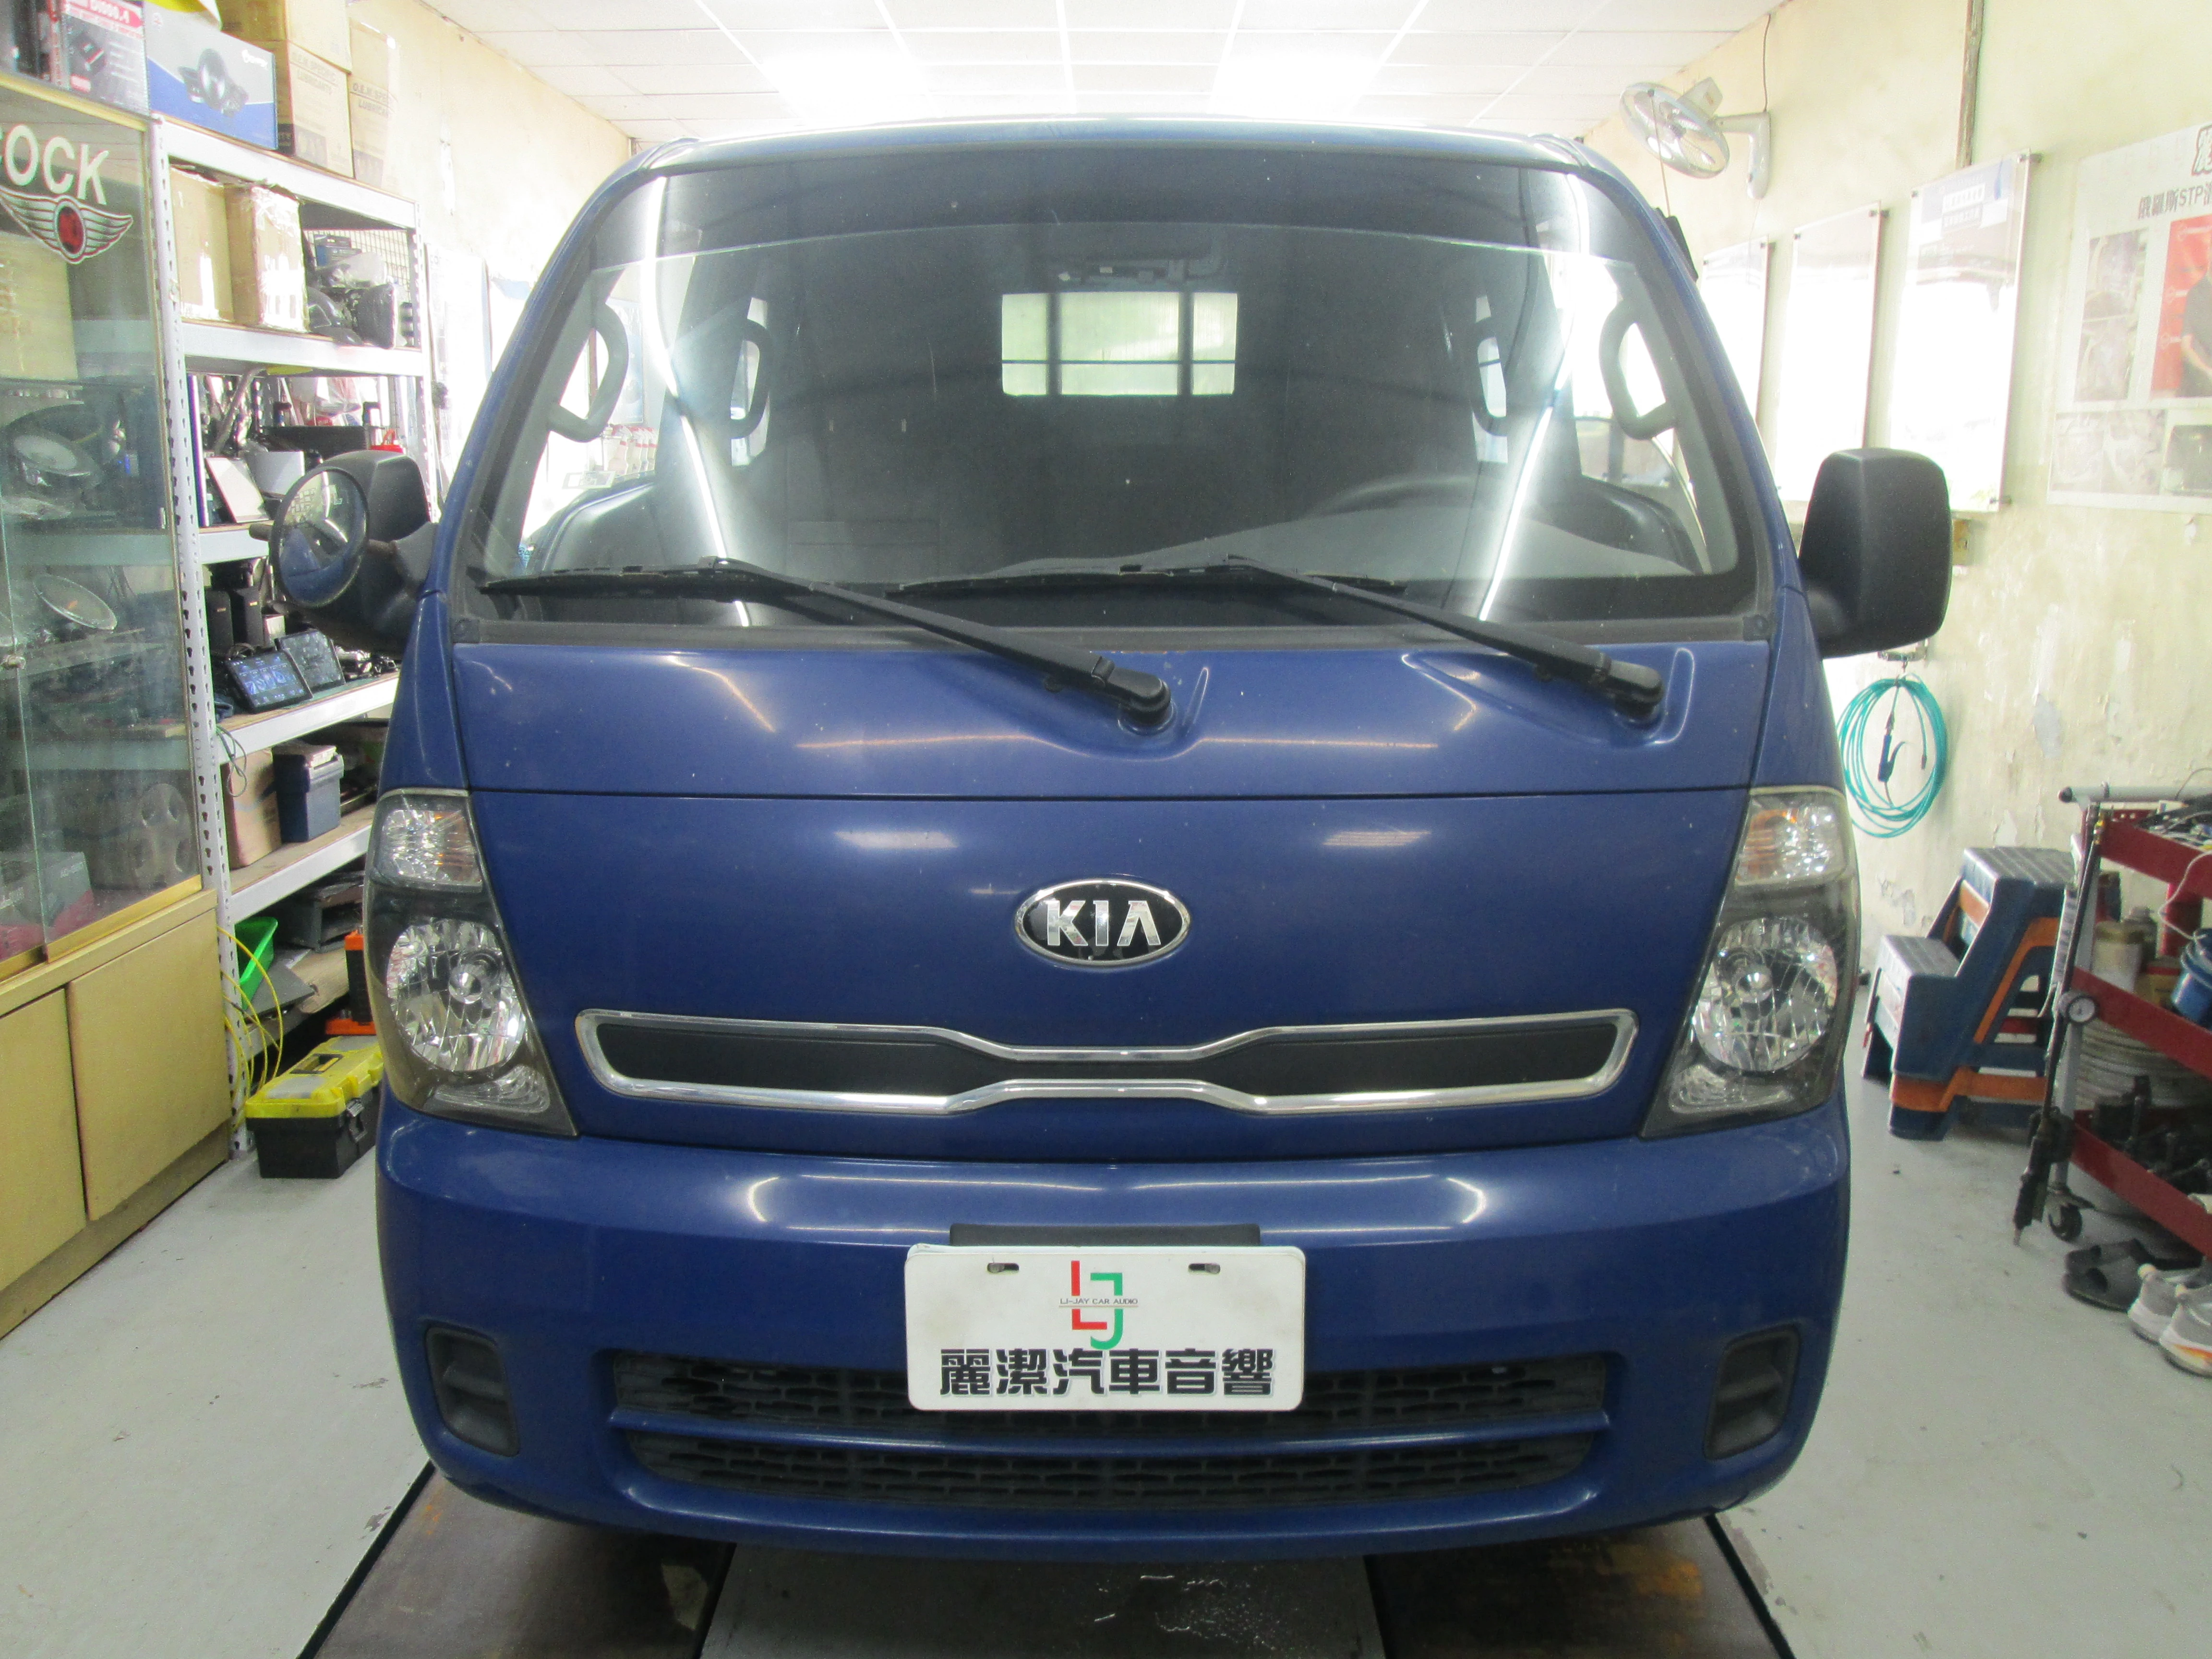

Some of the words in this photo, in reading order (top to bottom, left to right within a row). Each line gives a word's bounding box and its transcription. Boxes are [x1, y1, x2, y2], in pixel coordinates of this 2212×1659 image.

[0, 123, 110, 205] OCK
[1045, 900, 1161, 947] KIA
[939, 1348, 1275, 1396] 麗潔汽車音響
